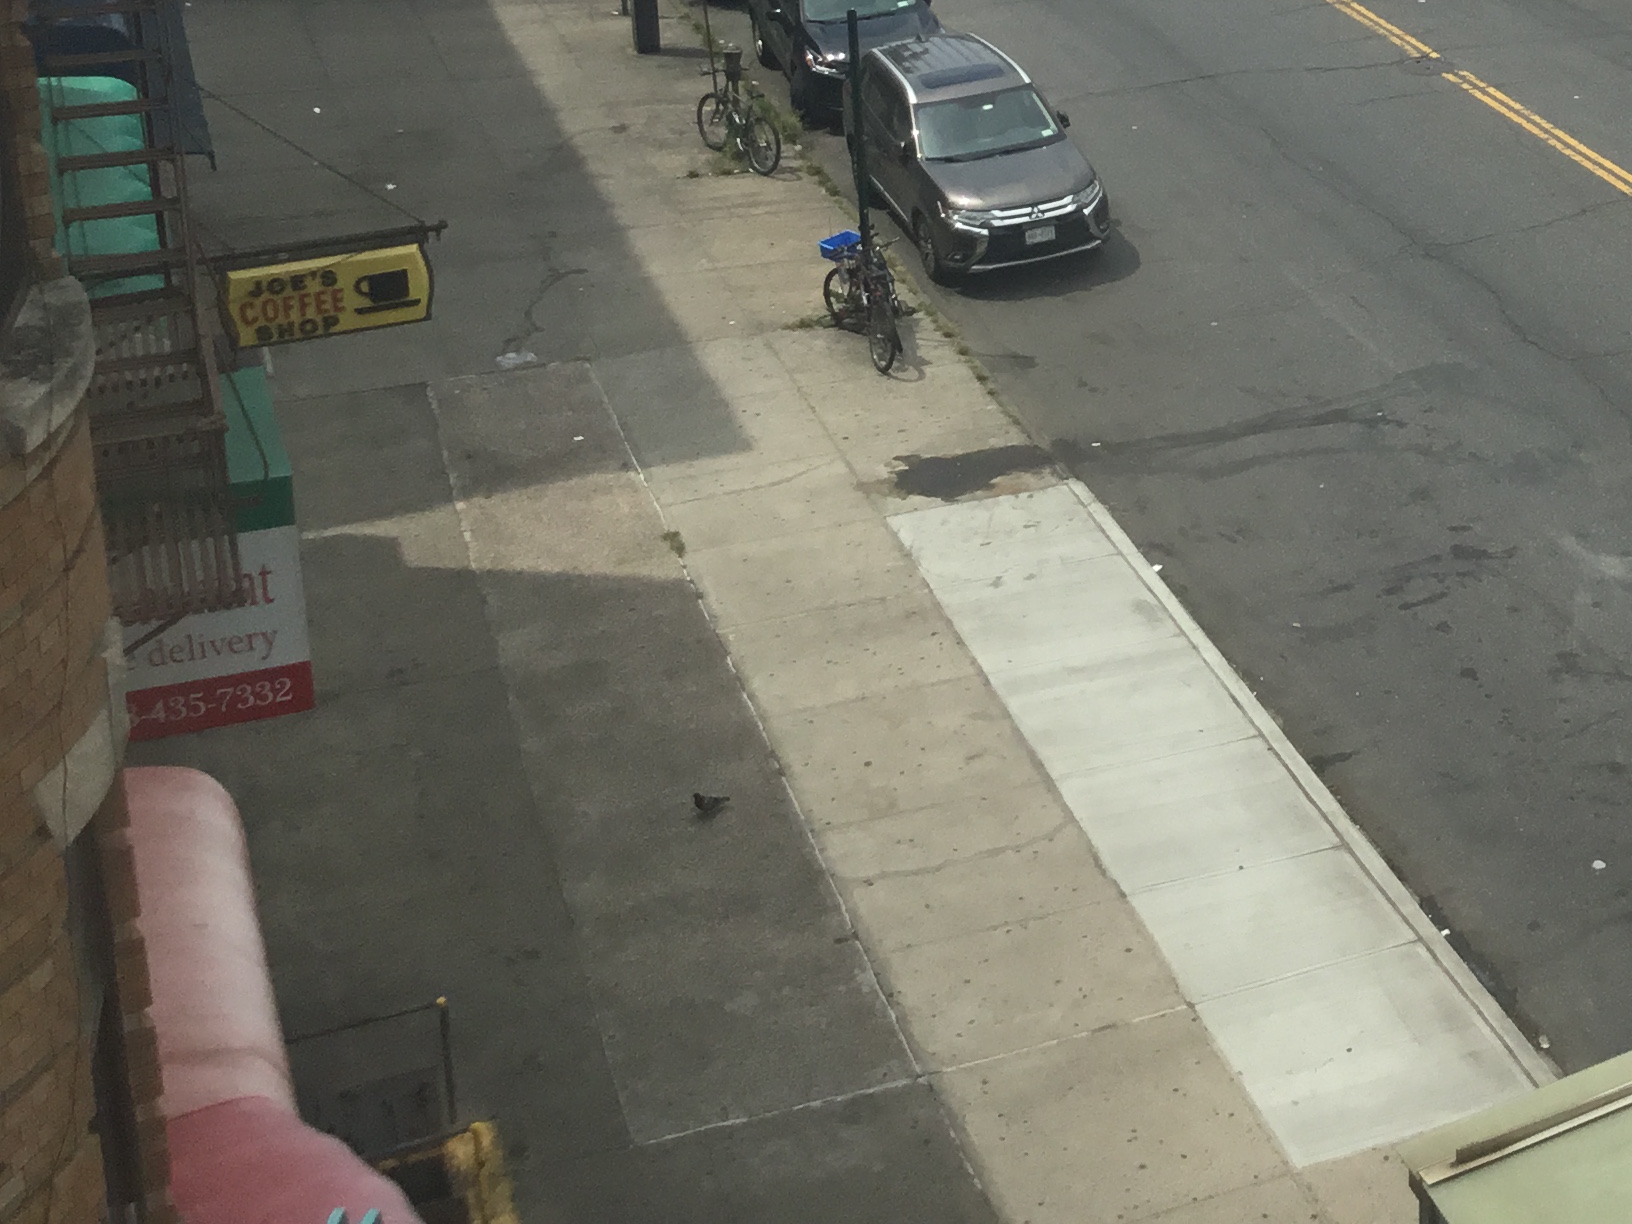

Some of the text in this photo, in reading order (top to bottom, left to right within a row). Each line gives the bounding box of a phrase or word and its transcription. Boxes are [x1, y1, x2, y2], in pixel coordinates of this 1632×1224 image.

[249, 269, 337, 298] JOE'S
[239, 287, 345, 325] COFFEE
[255, 314, 340, 342] SHOP
[147, 630, 278, 668] delivery
